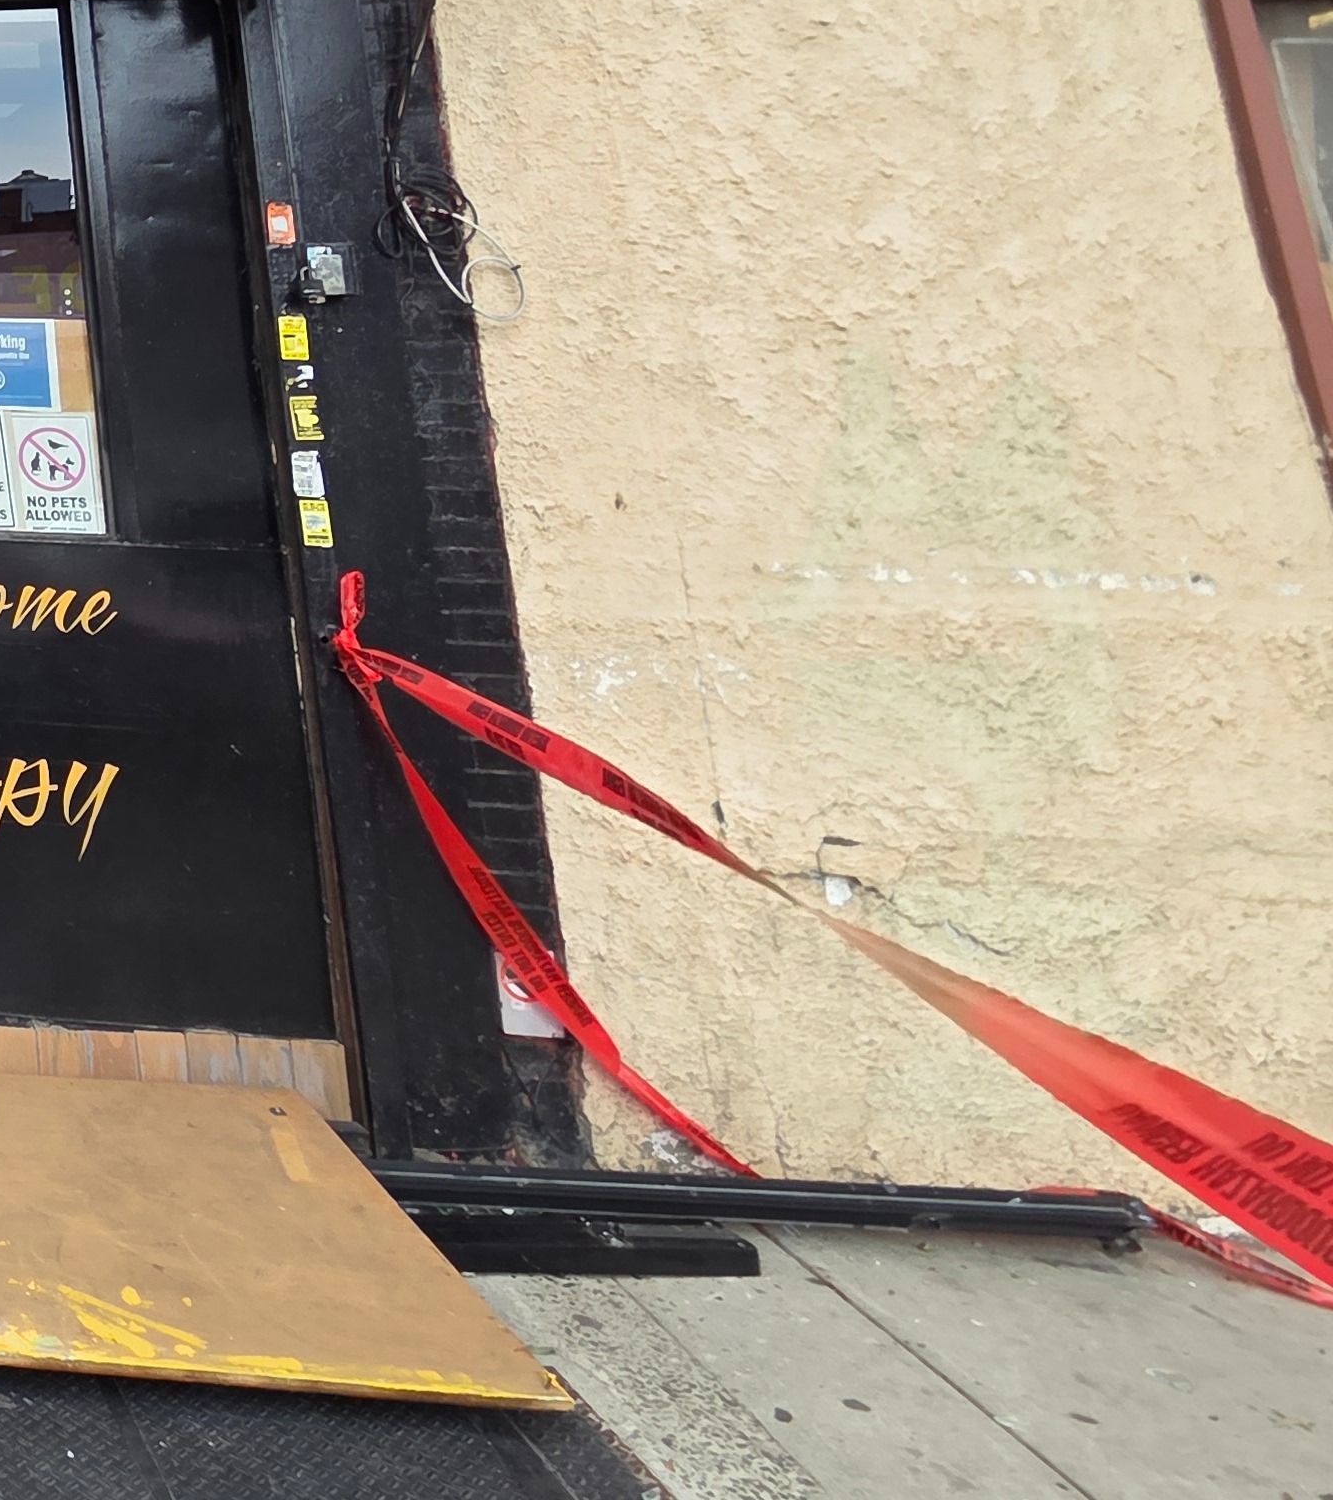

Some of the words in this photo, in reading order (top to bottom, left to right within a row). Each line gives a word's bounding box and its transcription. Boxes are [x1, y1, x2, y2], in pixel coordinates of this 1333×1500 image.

[27, 496, 47, 508] NO
[51, 497, 87, 509] PETS
[25, 510, 92, 523] ALLOWED
